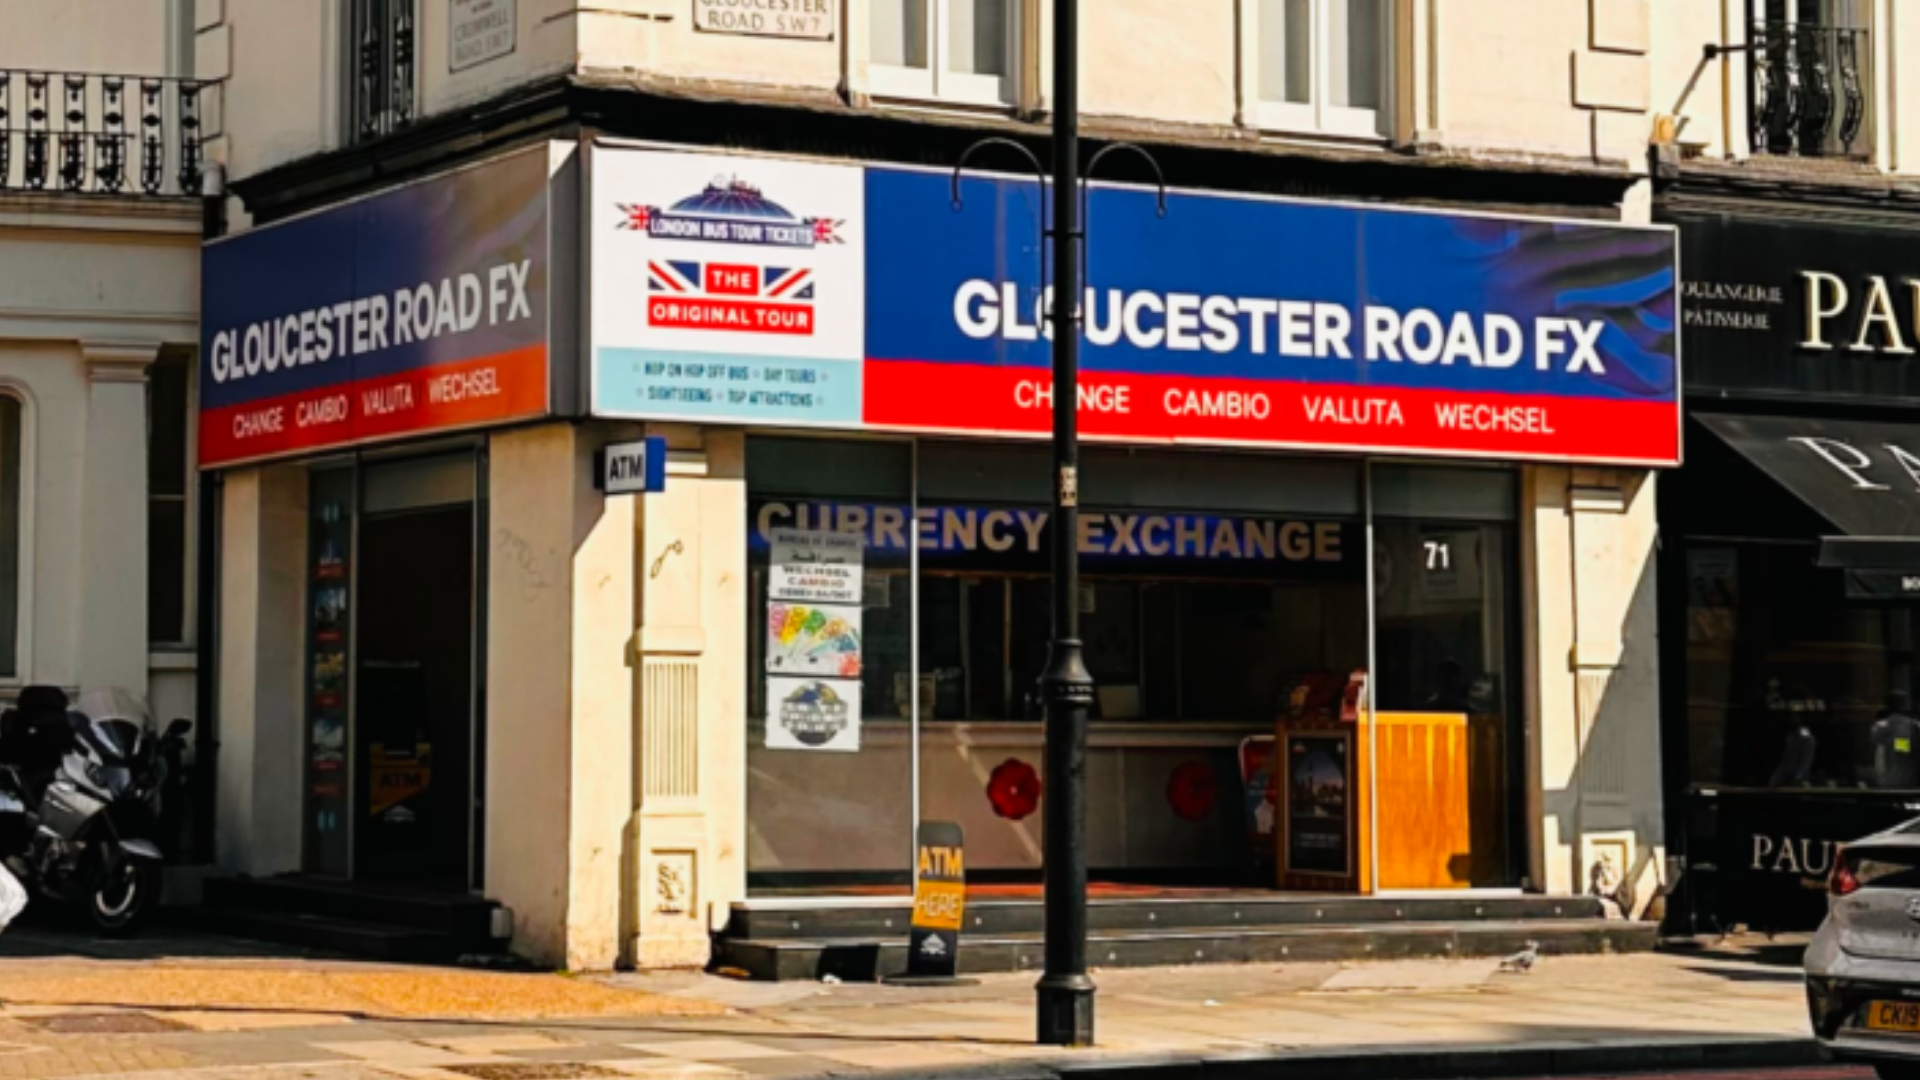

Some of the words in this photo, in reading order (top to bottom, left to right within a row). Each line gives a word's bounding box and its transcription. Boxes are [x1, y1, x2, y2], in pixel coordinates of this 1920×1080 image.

[708, 10, 764, 30] ROAD
[651, 218, 700, 235] LONDON
[703, 220, 729, 239] BUS
[730, 222, 762, 241] TOUR
[765, 225, 814, 246] TICKETS
[711, 270, 752, 289] THE
[211, 294, 390, 383] GLOUCESTER
[393, 272, 482, 346] ROAD
[489, 259, 533, 326] FX
[653, 303, 749, 325] ORIGINAL
[755, 308, 809, 328] TOUR
[1363, 305, 1524, 369] ROAD
[1535, 316, 1606, 374] FX
[645, 362, 665, 376] HOP
[685, 363, 704, 378] HOP
[728, 366, 749, 380] BUS
[785, 368, 816, 384] TOURS
[233, 406, 285, 438] CHANGE
[295, 395, 348, 428] CAMBIO
[361, 383, 414, 416] VALUTA
[426, 367, 502, 406] WECHSEL
[648, 385, 712, 403] SIGHTSEEING
[748, 389, 813, 407] ATTRACTIONS
[1014, 379, 1130, 414] CHNGE
[1163, 388, 1271, 420] CAMBIO
[1302, 395, 1404, 426] VALUTA
[1435, 402, 1556, 434] WECHSEL
[609, 453, 644, 481] ATM
[757, 502, 1049, 552] CURRENCY
[1076, 513, 1342, 562] EXCHANGE
[1423, 541, 1450, 570] 71
[380, 772, 422, 788] ATM
[919, 846, 963, 877] ATM
[1750, 834, 1848, 875] PAU
[916, 890, 959, 919] HERE
